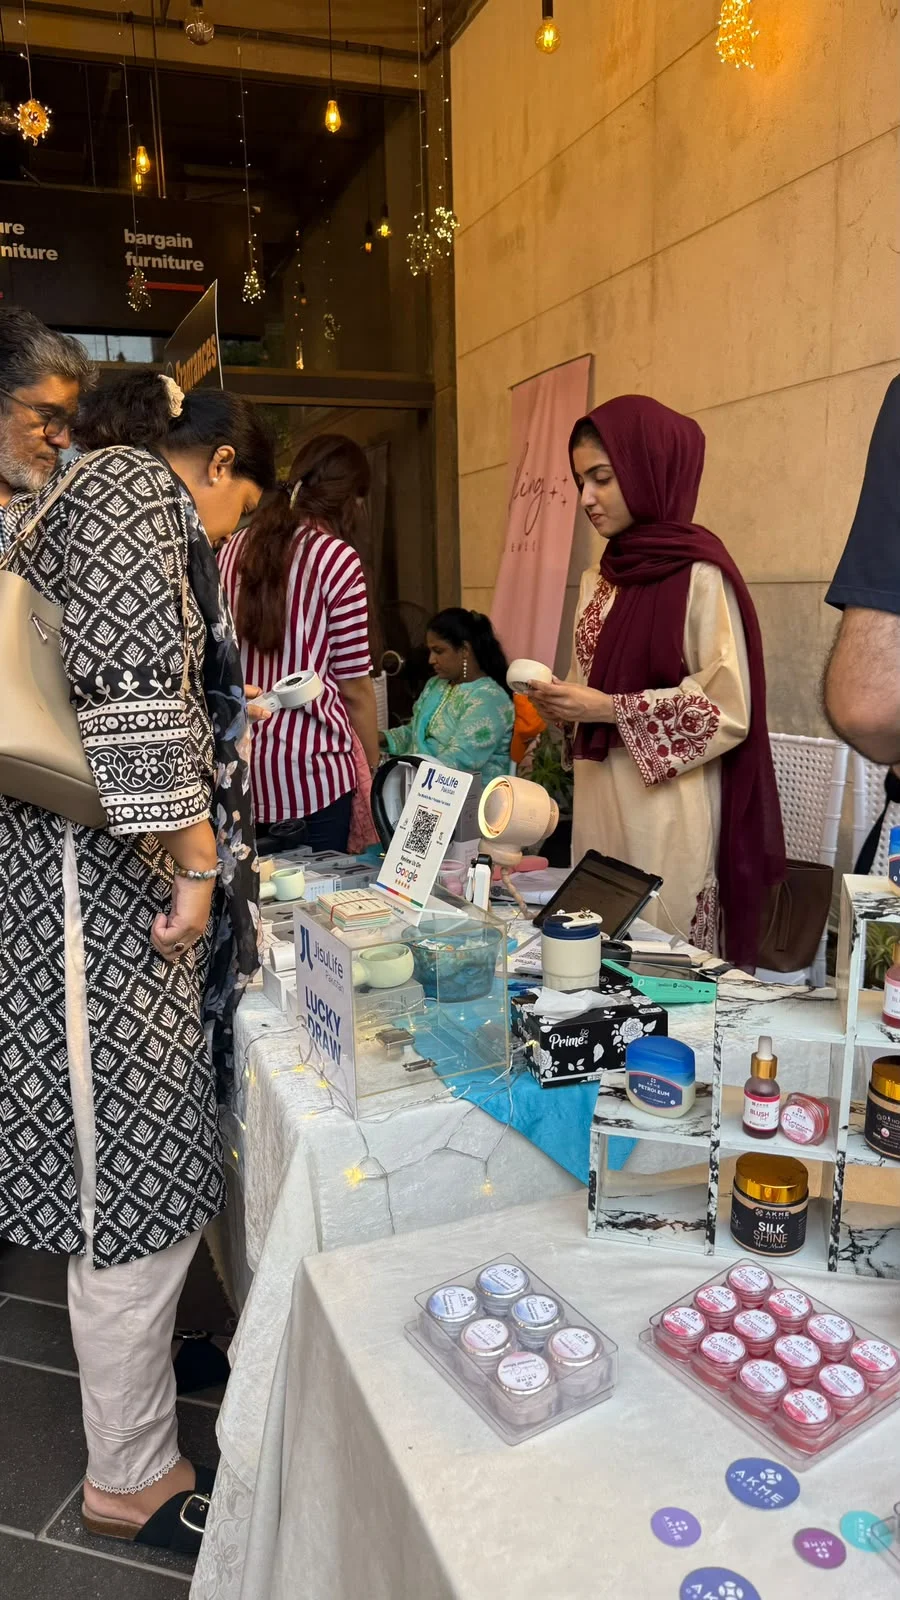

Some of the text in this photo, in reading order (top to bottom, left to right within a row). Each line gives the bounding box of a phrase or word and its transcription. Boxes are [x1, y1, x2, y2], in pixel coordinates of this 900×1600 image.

[124, 228, 193, 250] bargain
[125, 251, 205, 272] furniture
[434, 773, 459, 789] JisuLife
[395, 862, 418, 883] Google
[313, 941, 344, 979] JisuLife
[305, 985, 341, 1037] LUCKY
[307, 1013, 342, 1066] DRAW
[549, 1033, 584, 1050] Prime
[637, 1083, 670, 1097] PETROLEUM
[750, 1109, 770, 1118] BLUSH
[753, 1230, 788, 1243] SHINE
[758, 1221, 785, 1234] SILK
[735, 1470, 784, 1504] AKME
[664, 1515, 682, 1541] AKME
[802, 1540, 833, 1549] AKME
